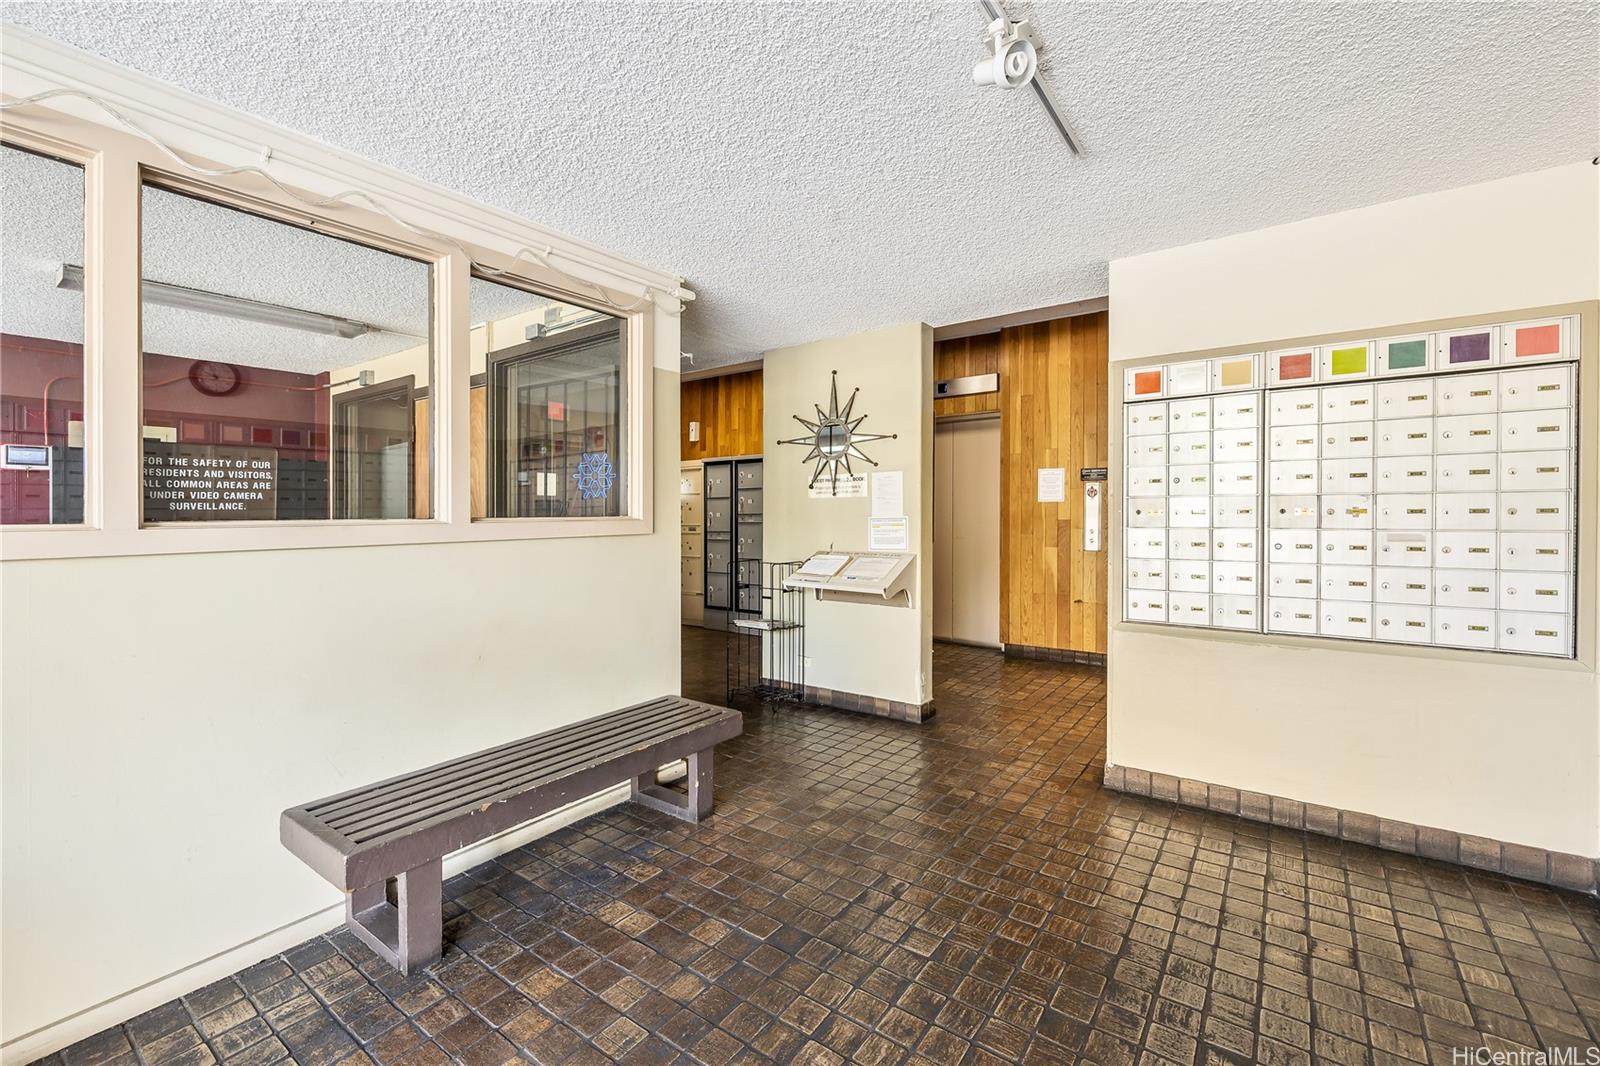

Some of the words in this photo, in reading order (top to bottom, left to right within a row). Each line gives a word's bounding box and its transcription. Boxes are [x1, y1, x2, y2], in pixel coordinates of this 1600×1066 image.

[144, 457, 163, 465] FOR
[168, 458, 188, 466] THE
[193, 459, 231, 467] SAFETY
[236, 460, 248, 468] OF
[252, 461, 271, 469] OUR
[144, 468, 200, 477] RESIDENTS
[204, 470, 224, 478] AND
[228, 471, 273, 480] VISITORS,
[144, 480, 161, 488] ALL
[166, 480, 212, 488] COMMON
[216, 481, 249, 489] AREAS
[253, 482, 271, 490] ARE
[150, 491, 185, 499] UNDER
[190, 492, 220, 500] VIDEO
[223, 492, 263, 500] CAMERA
[169, 502, 247, 510] SURVEILLANCE.
